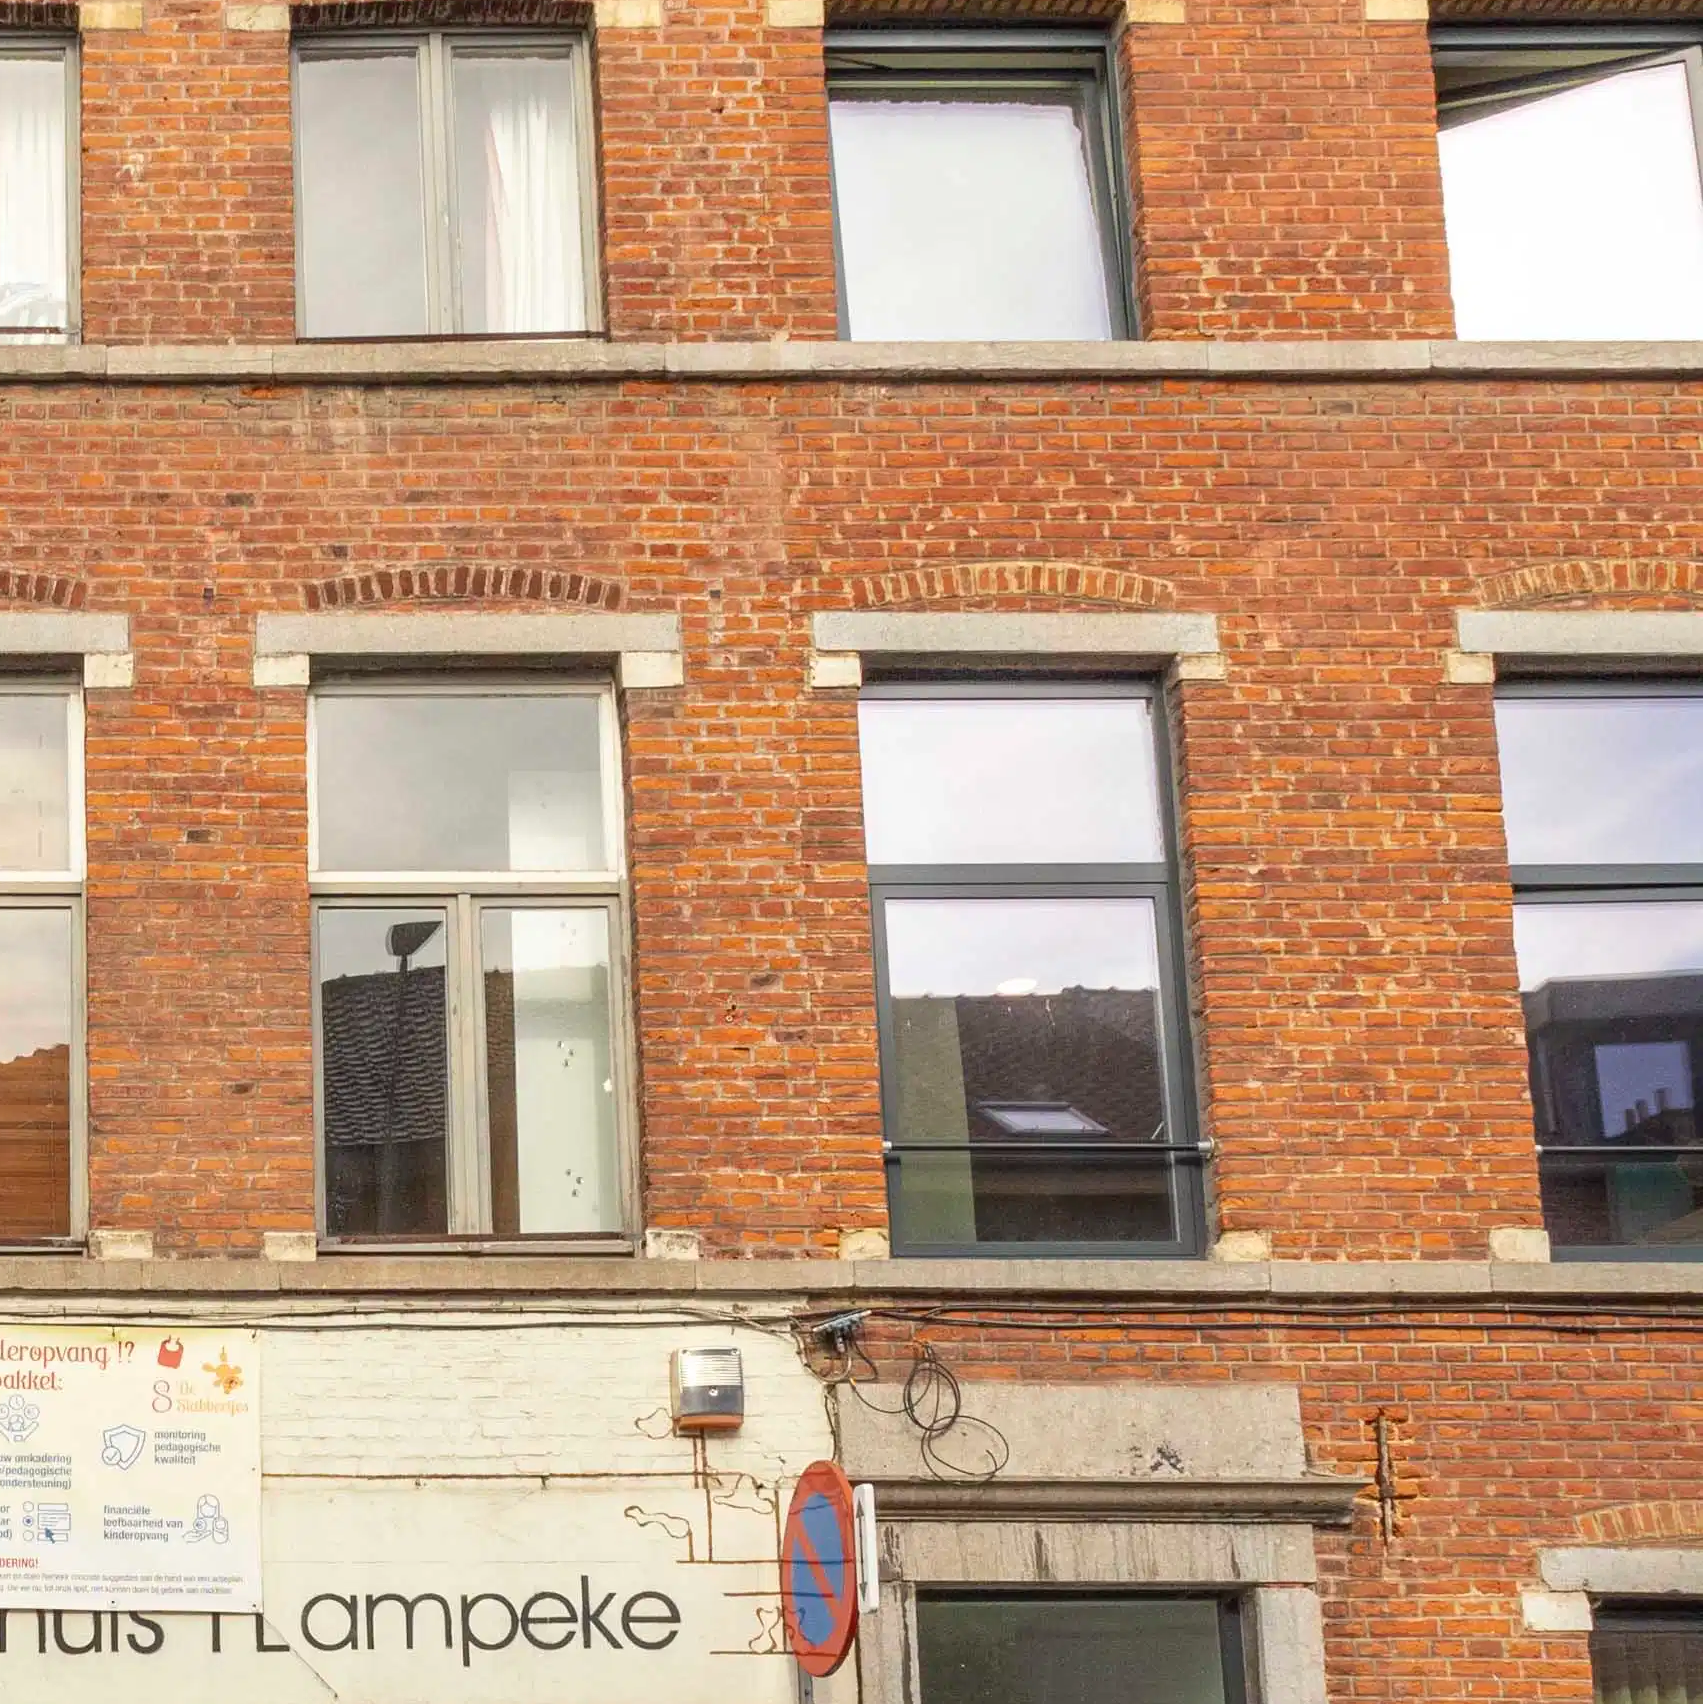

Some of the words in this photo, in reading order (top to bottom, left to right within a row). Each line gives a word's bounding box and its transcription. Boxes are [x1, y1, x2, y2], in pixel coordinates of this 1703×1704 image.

[117, 1340, 136, 1364] !?
[154, 1429, 207, 1442] monitoring
[154, 1442, 222, 1455] pedagogische
[14, 1453, 72, 1466] omkadering
[154, 1454, 197, 1465] kwaliteit
[0, 1478, 73, 1490] ondersteuning)
[103, 1517, 164, 1529] leefbaarheid
[165, 1518, 184, 1529] van
[103, 1529, 169, 1543] kinderopvang
